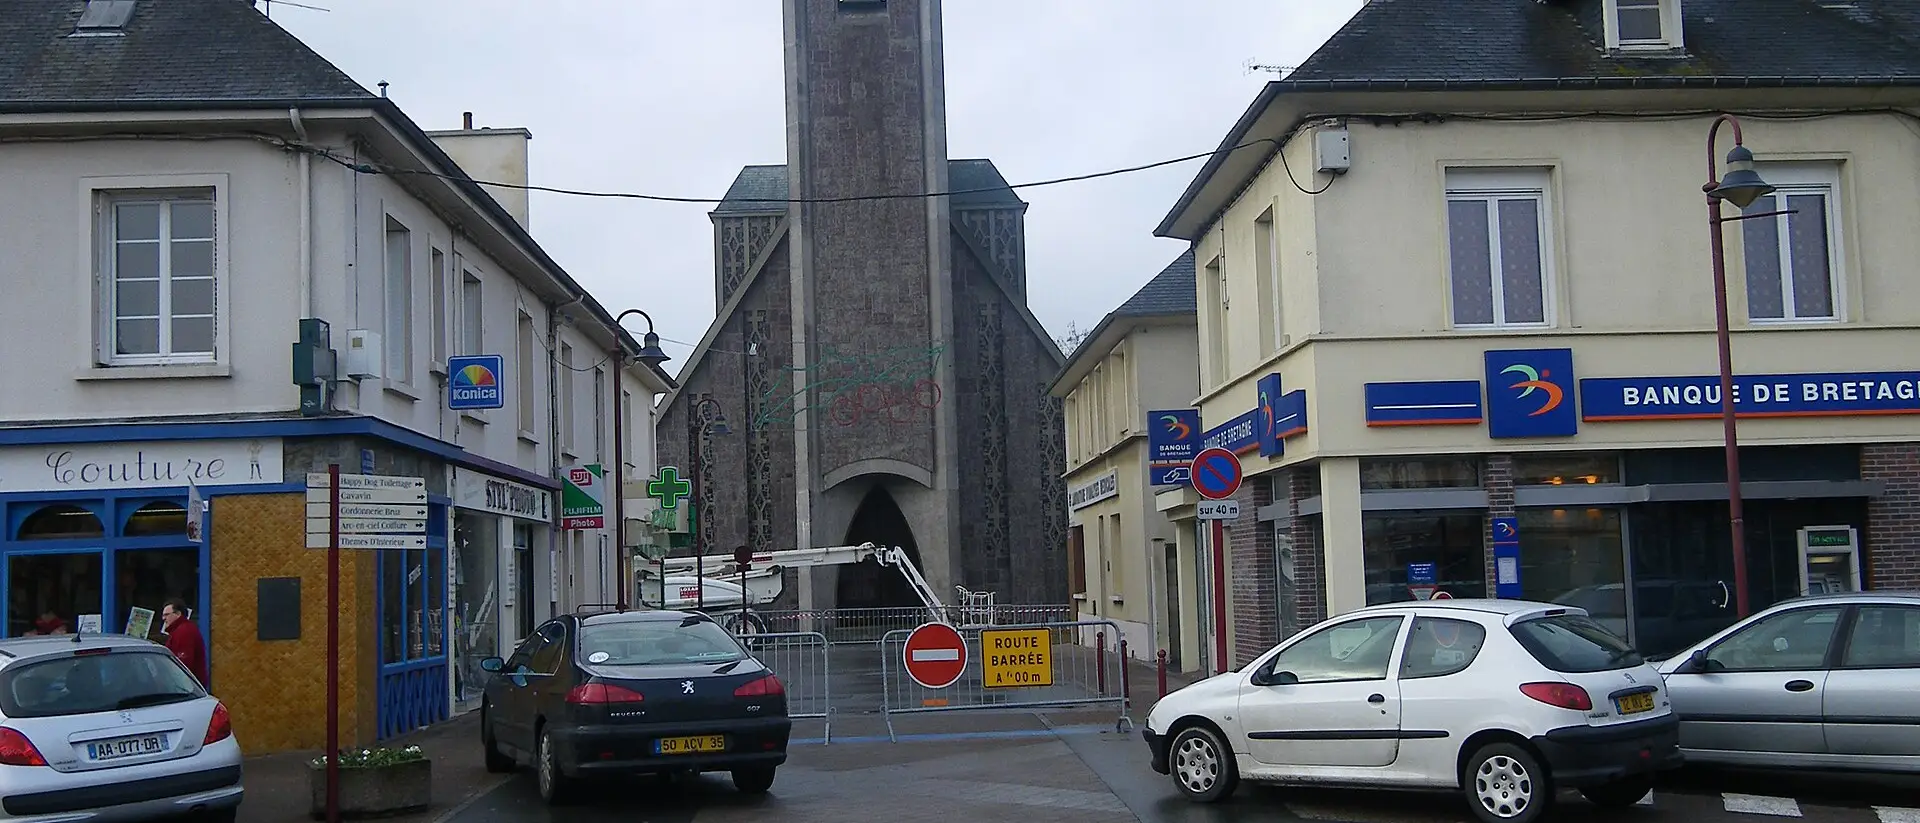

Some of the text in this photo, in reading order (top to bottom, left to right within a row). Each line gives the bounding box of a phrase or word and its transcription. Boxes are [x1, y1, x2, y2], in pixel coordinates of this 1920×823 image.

[453, 387, 497, 400] Konica
[1623, 380, 1920, 406] BANQUE DE BRETAG
[46, 451, 225, 484] Couture
[341, 478, 361, 488] Happy
[364, 479, 377, 488] Dog
[341, 492, 371, 500] Cavavin
[564, 506, 602, 515] FUJIFILM
[1200, 505, 1237, 514] sur 40 m
[571, 519, 595, 527] Photo
[995, 636, 1038, 648] ROUTE
[991, 652, 1043, 666] BARRÉE
[997, 672, 1002, 683] A
[1032, 673, 1040, 682] m
[98, 737, 160, 757] AA-077-DR
[663, 737, 724, 751] 50 ACV 35
